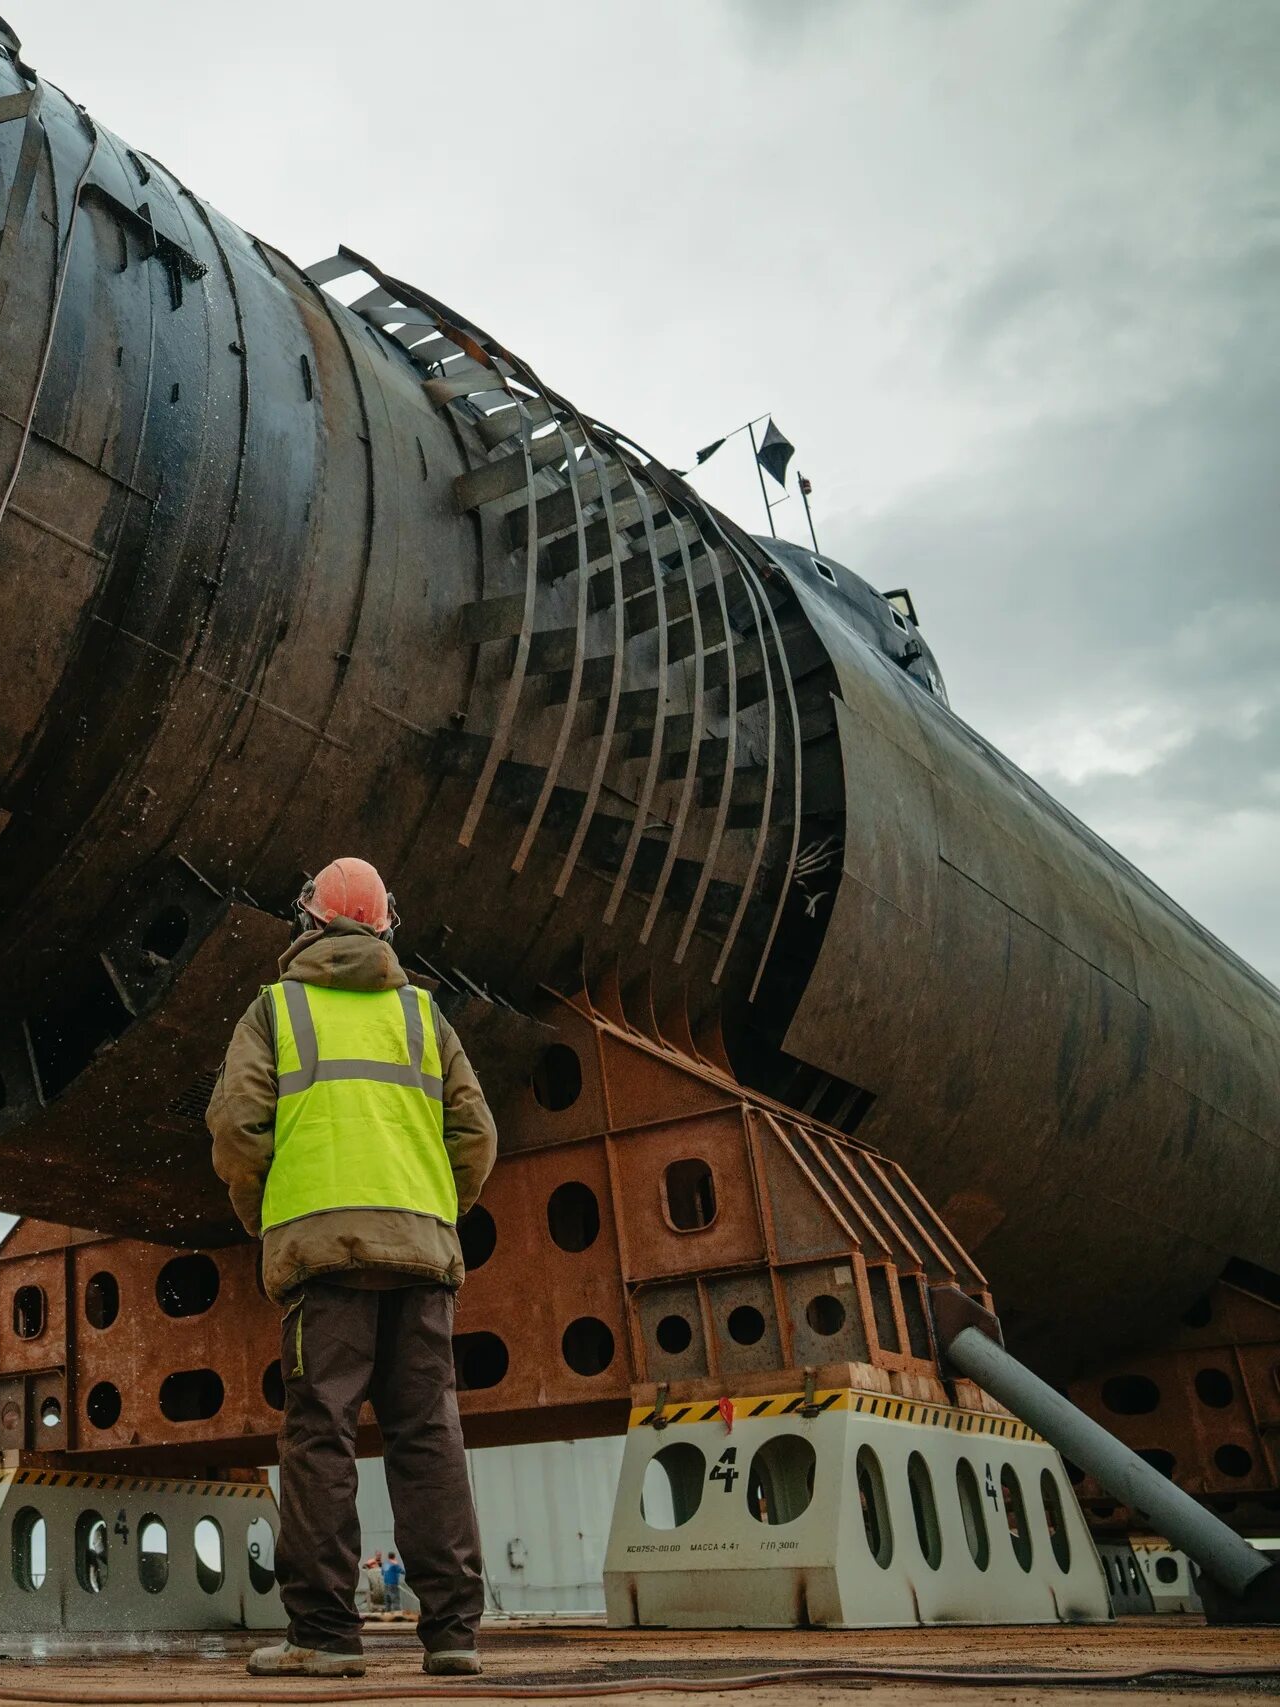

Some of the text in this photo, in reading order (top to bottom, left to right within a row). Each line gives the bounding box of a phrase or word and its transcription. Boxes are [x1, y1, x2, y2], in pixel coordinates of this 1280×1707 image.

[709, 1446, 739, 1493] 4
[984, 1462, 999, 1513] 4
[114, 1508, 130, 1546] 4
[690, 1543, 718, 1552] МАССА
